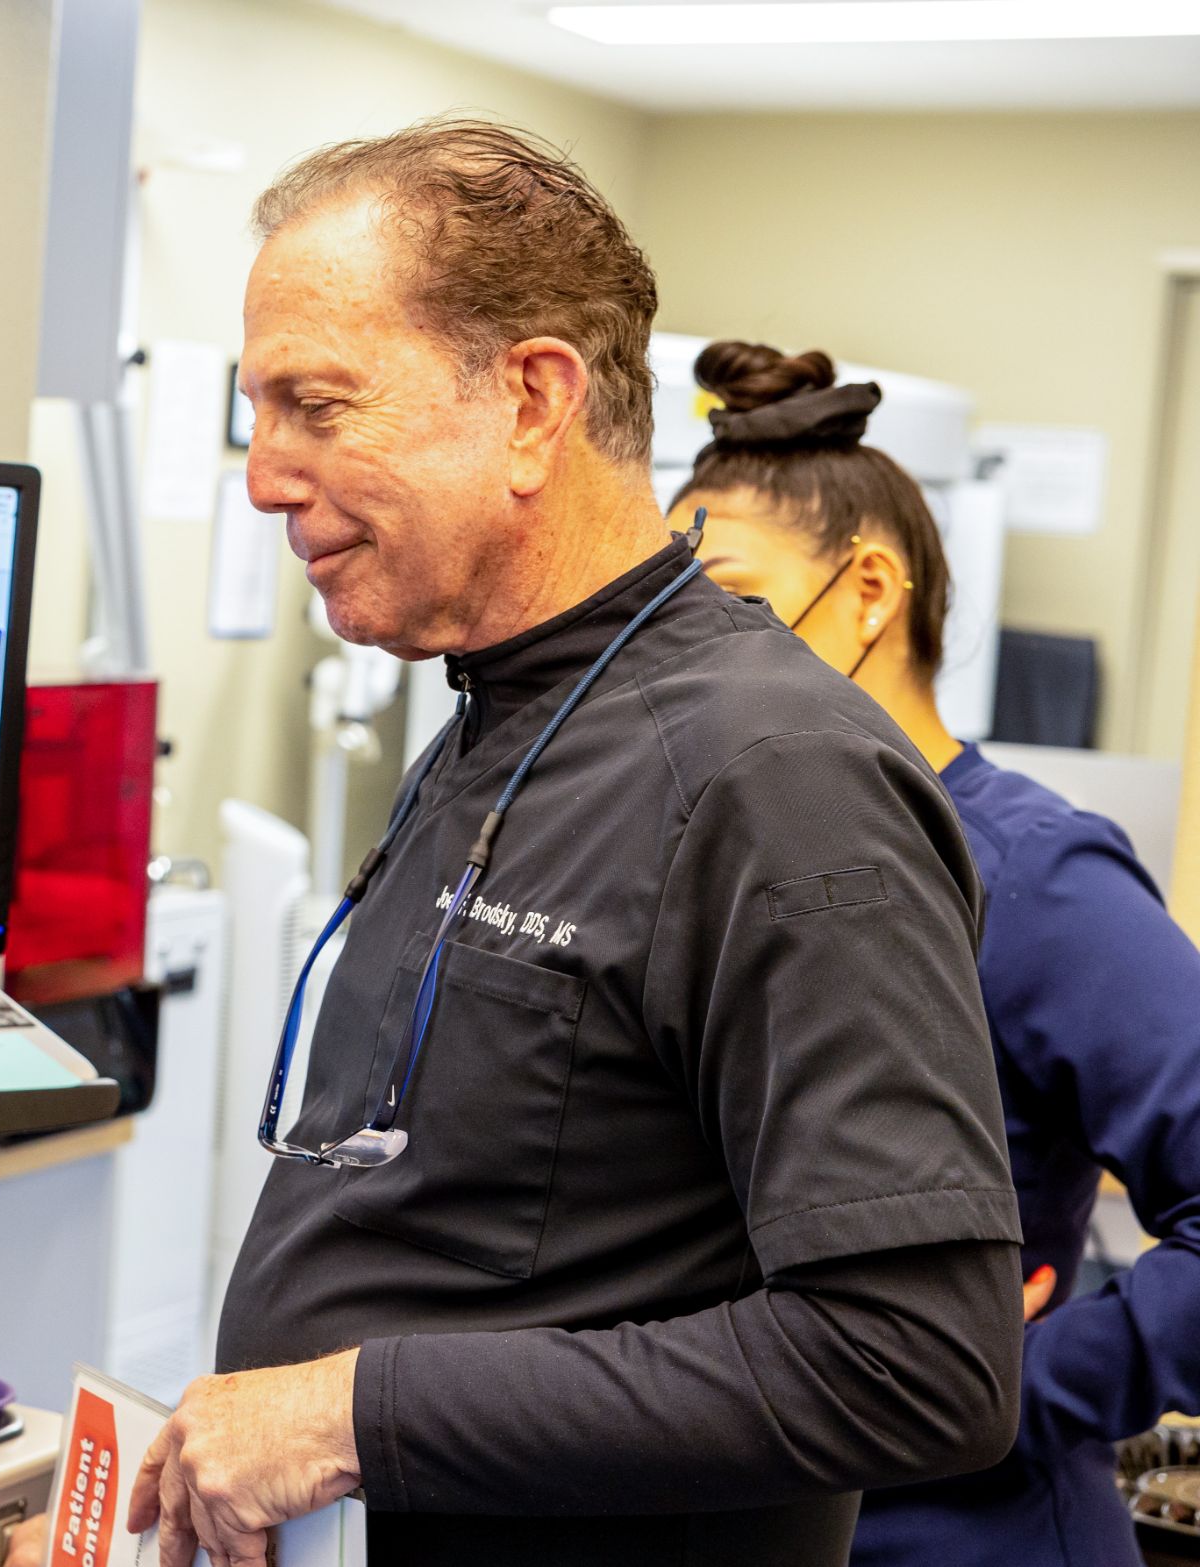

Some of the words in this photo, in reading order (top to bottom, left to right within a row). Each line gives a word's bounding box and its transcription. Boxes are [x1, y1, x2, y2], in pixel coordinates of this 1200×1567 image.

[468, 896, 518, 936] Brodsky,
[519, 911, 549, 944] DDS,
[549, 920, 577, 947] MS
[62, 1437, 94, 1557] Patient
